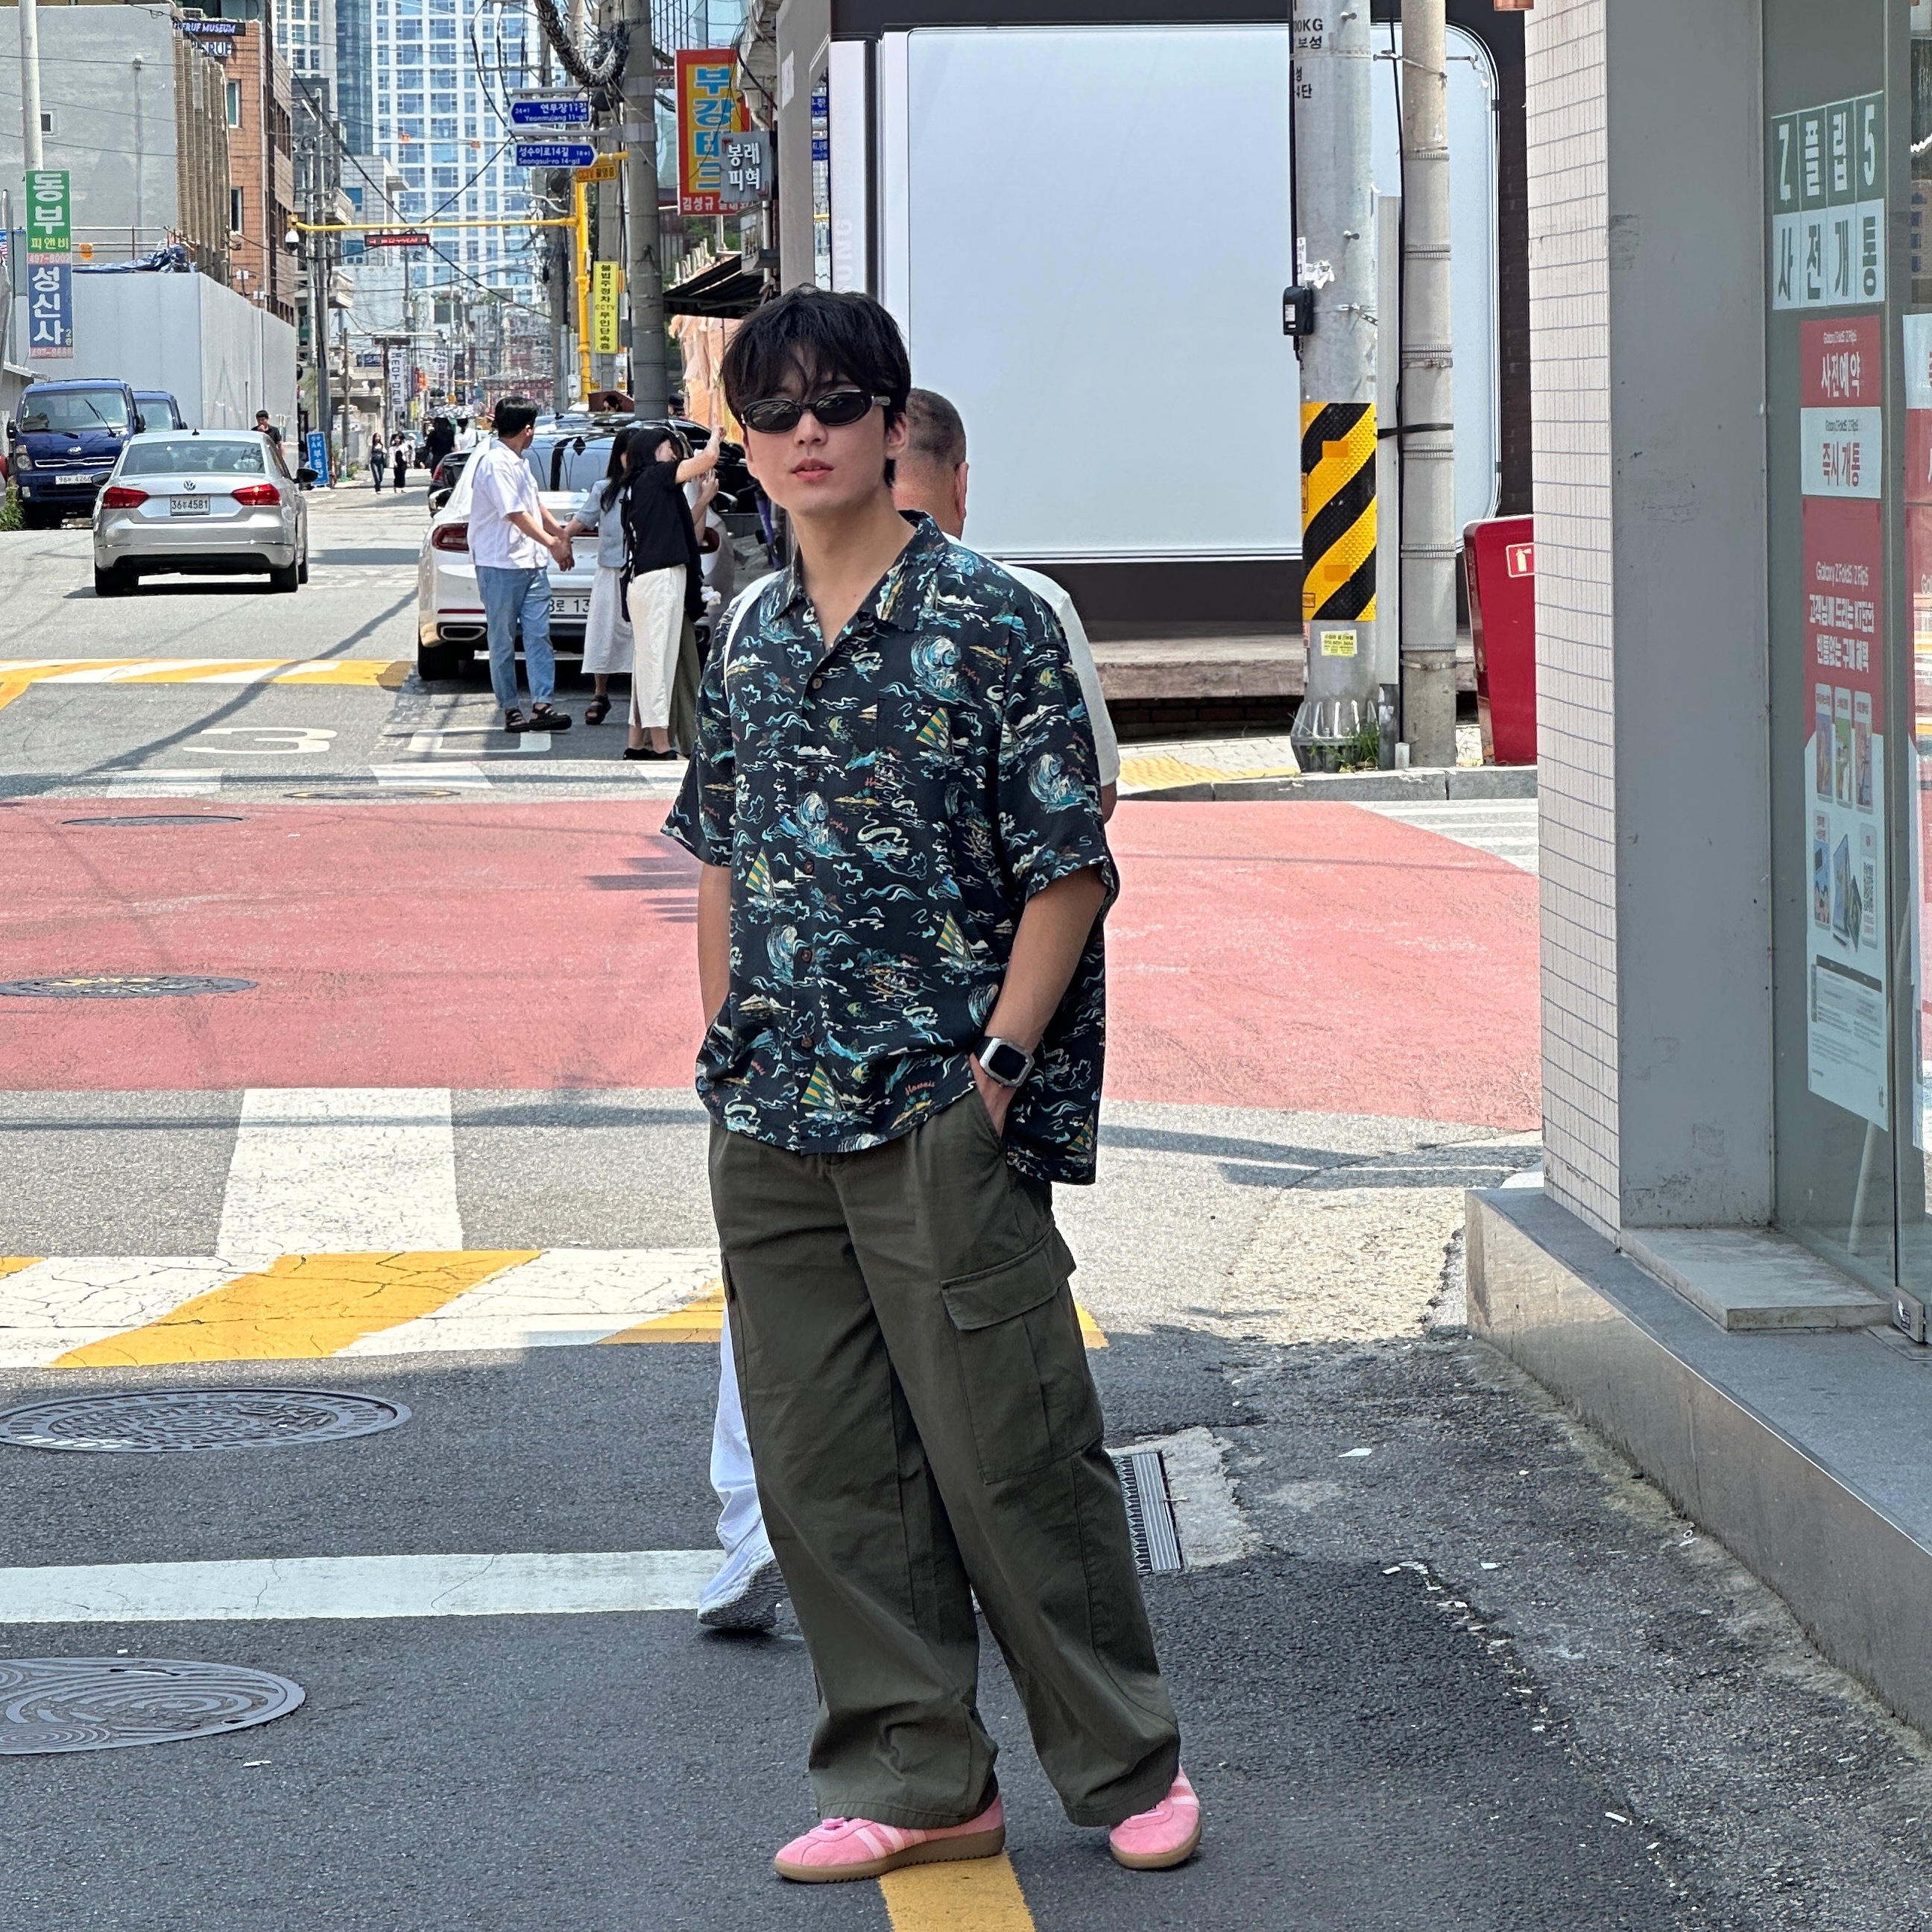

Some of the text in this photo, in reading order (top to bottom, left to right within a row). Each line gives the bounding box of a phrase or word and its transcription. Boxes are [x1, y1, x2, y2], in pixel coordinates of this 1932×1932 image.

[202, 23, 236, 33] MUSEUM
[540, 103, 587, 114] 연무장11길
[568, 113, 587, 121] 11-gil
[519, 147, 569, 157] 성수이로14길
[727, 142, 761, 167] 봉래
[1778, 104, 1875, 201] Z플립5
[728, 168, 761, 192] 피혁
[33, 173, 65, 235] 동부
[682, 196, 713, 212] 김성규
[31, 238, 69, 250] 피앤비
[1778, 216, 1877, 301] 사전개통
[601, 265, 611, 303] 불법주정차
[32, 266, 65, 345] 성신사
[600, 312, 610, 350] 무인단속중
[1821, 351, 1860, 397] 사전예약
[1809, 593, 1834, 628] 고객님께
[1835, 598, 1853, 630] 드리는
[1843, 637, 1855, 670] 구매
